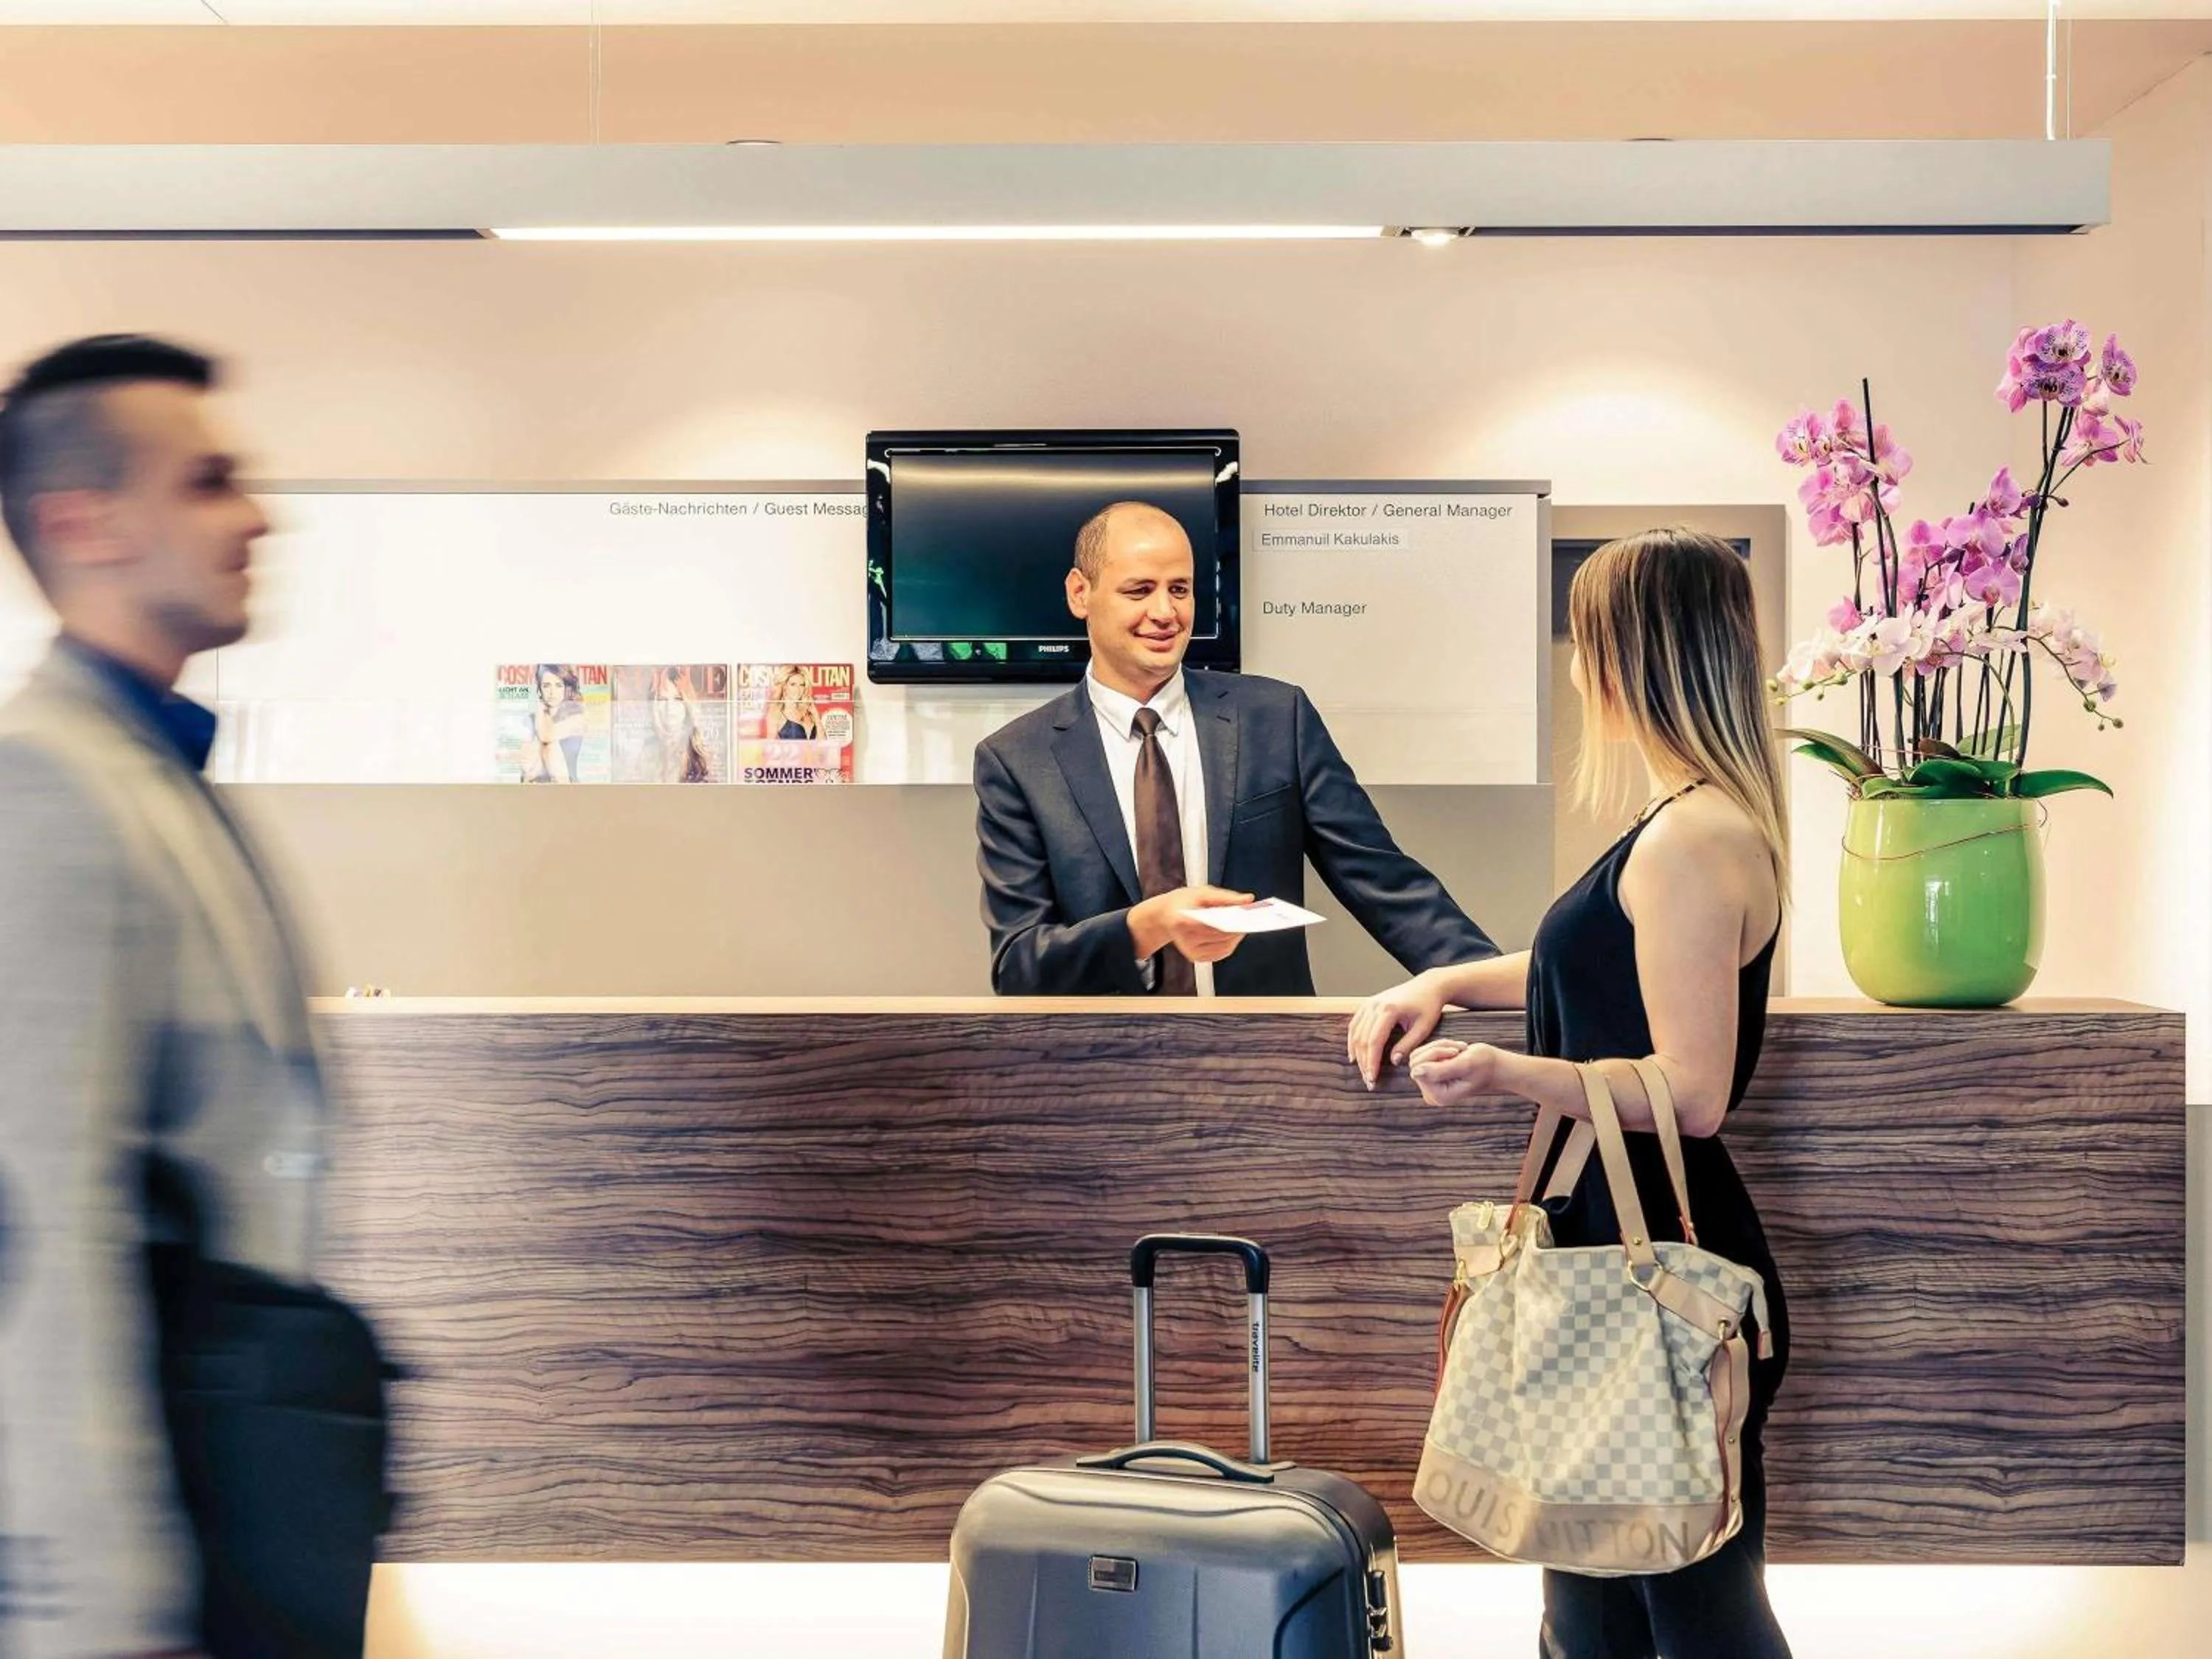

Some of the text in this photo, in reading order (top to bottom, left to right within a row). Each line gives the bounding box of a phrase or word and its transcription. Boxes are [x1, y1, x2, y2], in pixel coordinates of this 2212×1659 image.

[609, 501, 868, 519] Gäste-Nachrichten / Guest Messag
[1264, 504, 1513, 520] Hotel Direktor / General Manager
[1261, 532, 1400, 548] Emmanuil Kakulakis
[1263, 601, 1368, 617] Duty Manager
[497, 664, 608, 685] COSMITAN
[738, 666, 850, 686] COSLITAN
[1426, 1470, 1519, 1537] OUIS
